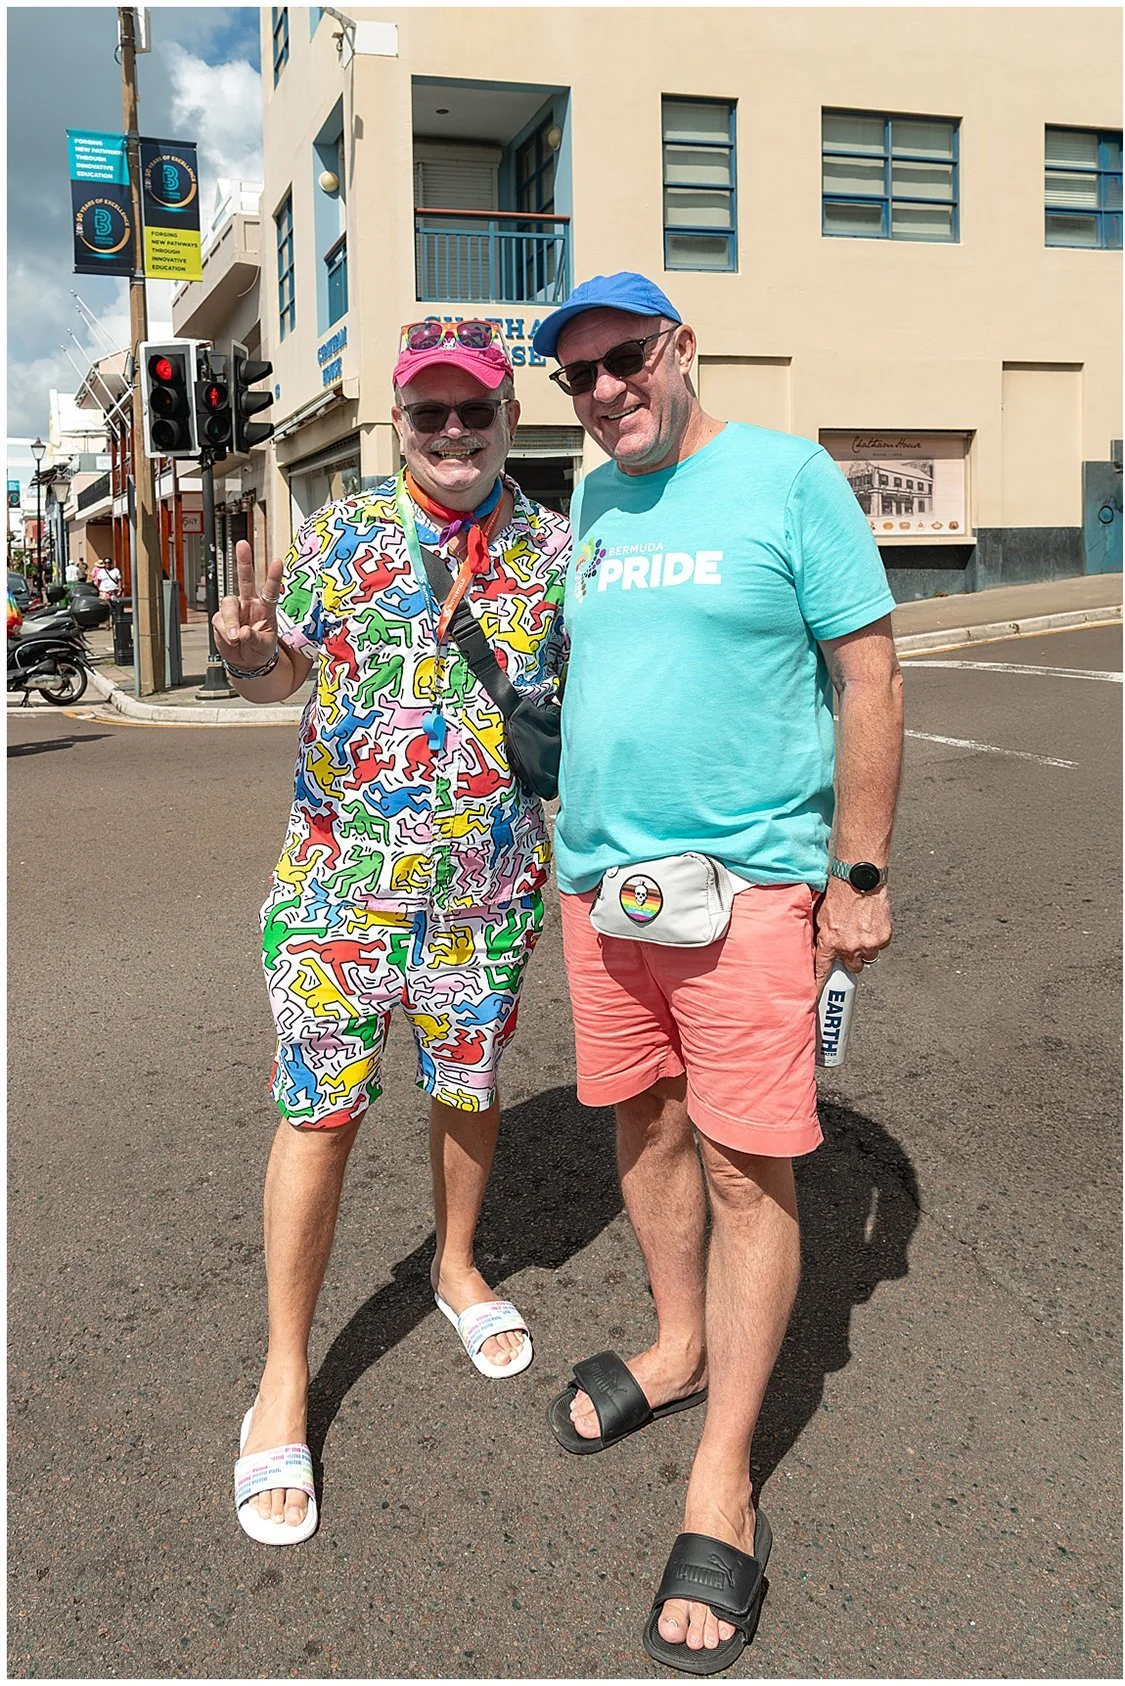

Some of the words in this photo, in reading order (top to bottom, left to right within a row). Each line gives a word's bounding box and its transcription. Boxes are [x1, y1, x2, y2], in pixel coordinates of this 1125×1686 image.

[75, 154, 107, 162] THROUGH
[76, 162, 114, 171] INNOVATIVE
[77, 170, 113, 179] EDUCATION
[167, 240, 198, 248] PATHWAYS
[152, 256, 187, 264] INNOVATIVE
[152, 264, 186, 272] EDUCATION
[852, 435, 894, 454] Chatham
[608, 541, 664, 557] BERMUDA
[597, 550, 724, 593] PRIDE
[822, 990, 846, 1052] EARTH
